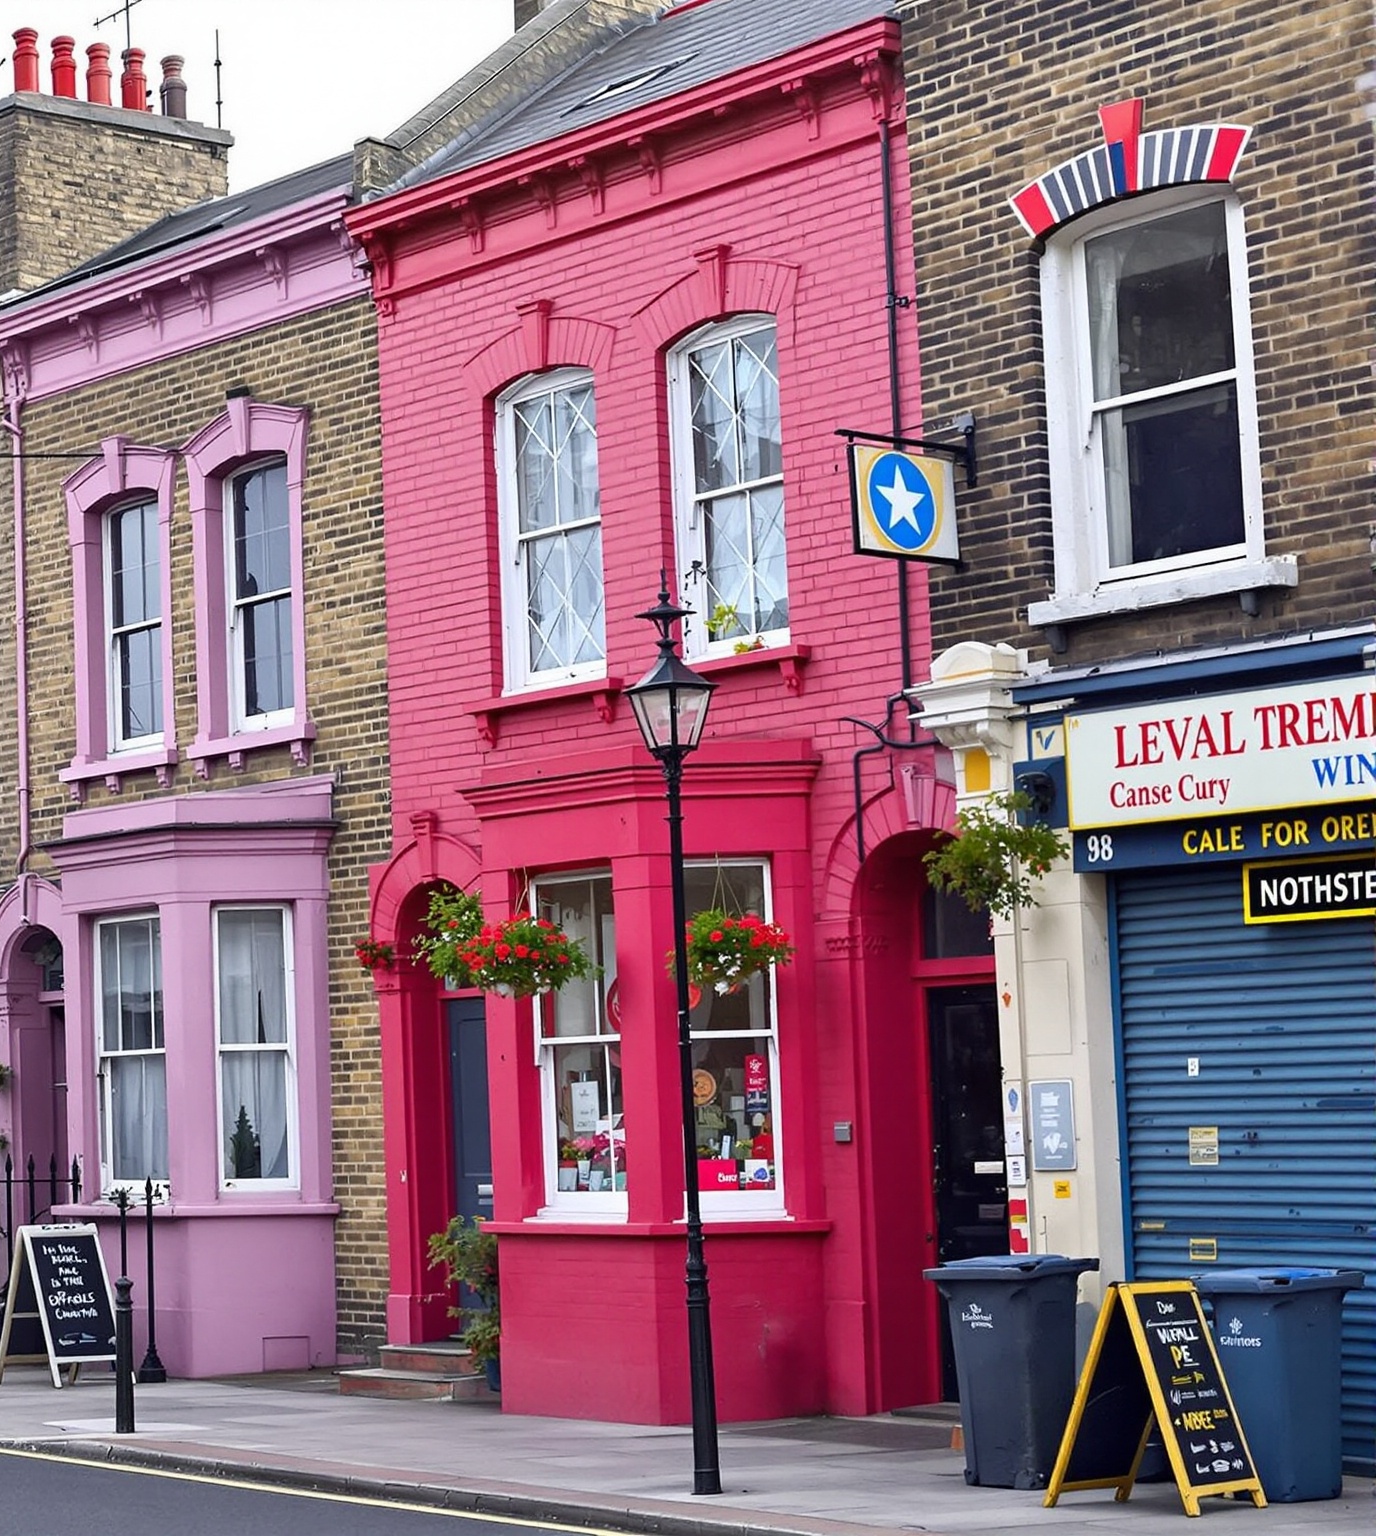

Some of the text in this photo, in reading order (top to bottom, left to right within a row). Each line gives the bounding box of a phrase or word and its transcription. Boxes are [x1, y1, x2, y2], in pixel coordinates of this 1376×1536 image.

[1114, 711, 1246, 768] LEVAL
[1110, 774, 1231, 809] Canse Cury
[1086, 834, 1114, 862] 98
[1182, 826, 1245, 855] CALE
[1261, 819, 1310, 848] FOR
[1260, 871, 1376, 908] NOTHSTE
